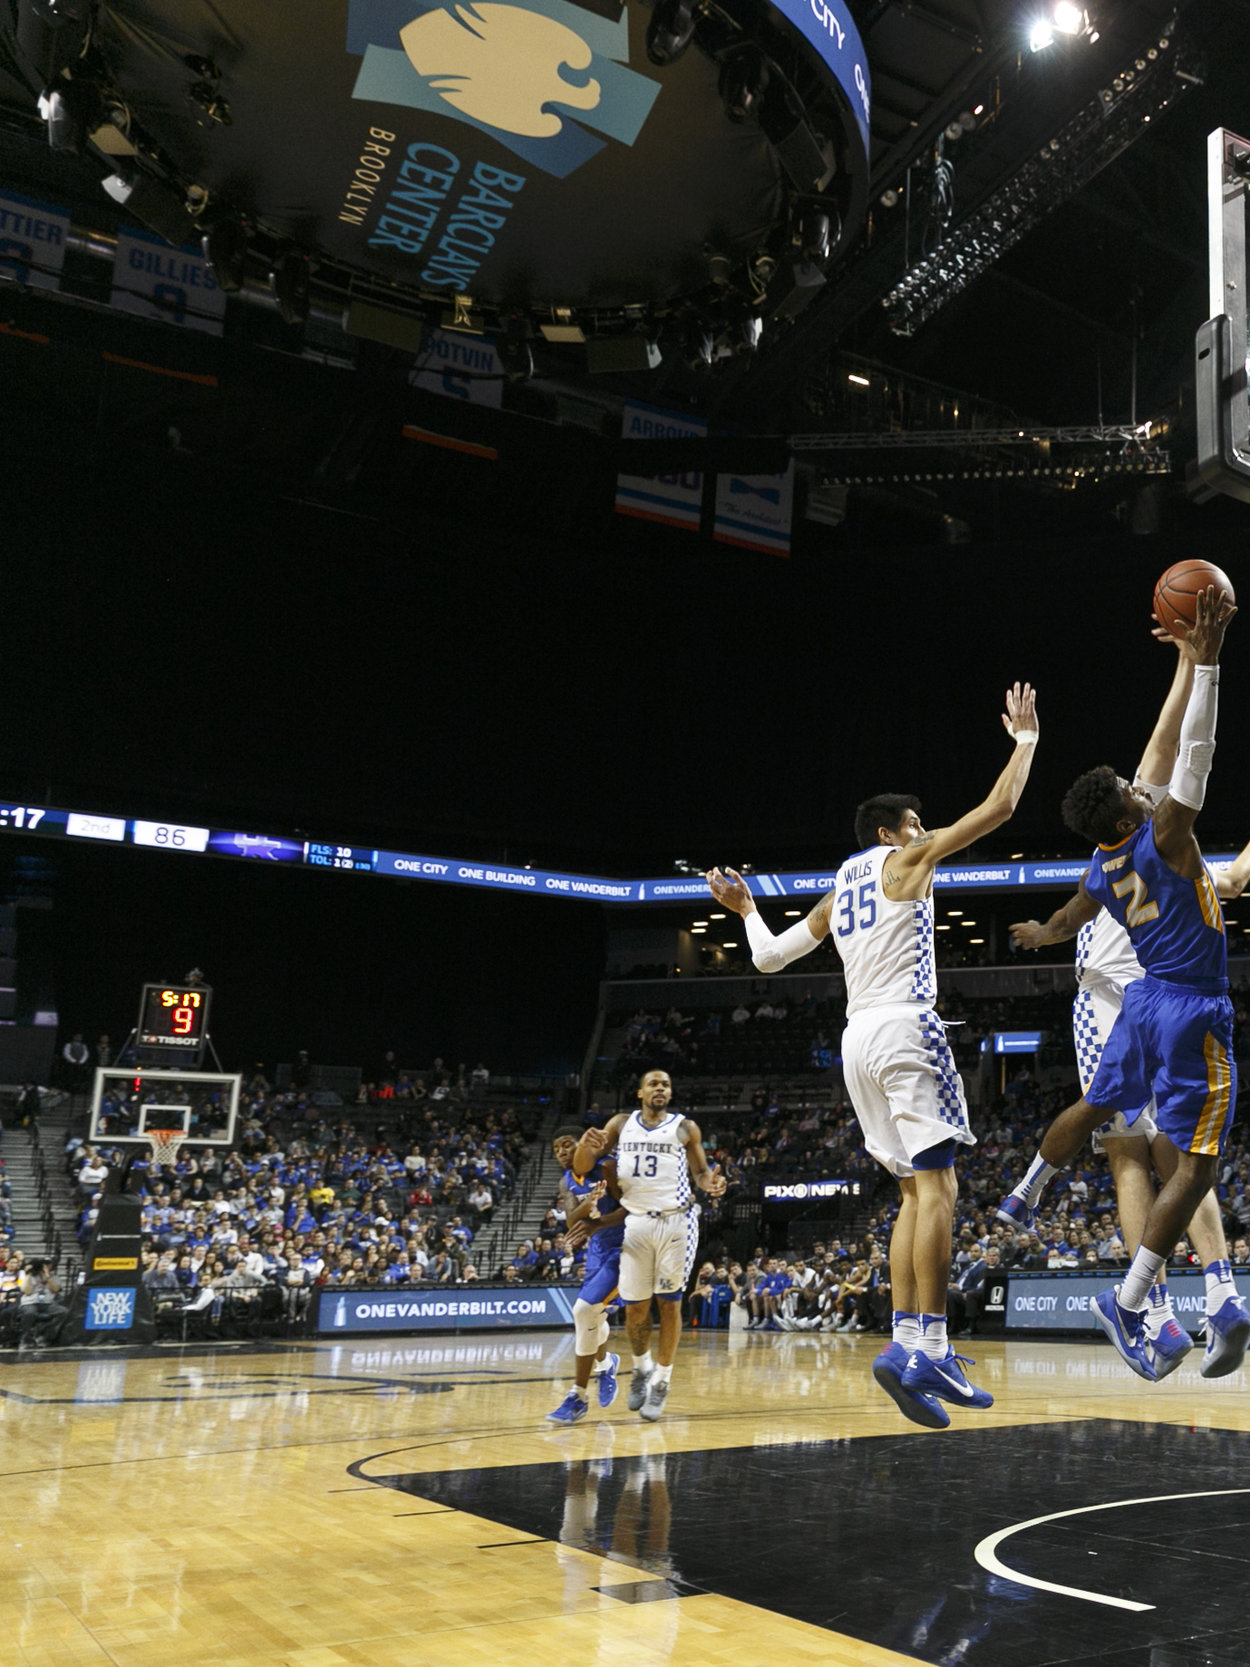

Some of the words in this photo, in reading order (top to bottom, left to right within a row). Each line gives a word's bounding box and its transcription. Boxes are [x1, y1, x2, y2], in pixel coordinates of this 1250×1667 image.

[338, 126, 396, 225] BROOKLYN
[367, 142, 460, 254] CENTER
[421, 160, 527, 291] BARCLAYS
[128, 248, 218, 290] GILLIES
[80, 819, 111, 835] 2nd
[154, 826, 187, 846] 86
[309, 853, 333, 866] TOL:
[310, 843, 333, 856] FLS:
[394, 859, 421, 873] ONE
[422, 862, 448, 875] CITY
[458, 867, 484, 880] ONE
[485, 870, 536, 887] BUILDING
[545, 878, 571, 890] ONE
[571, 881, 632, 896] VANDERBILT
[794, 879, 816, 889] ONE
[844, 860, 872, 885] WILLIS
[952, 870, 1010, 882] VANDERBILT
[837, 880, 876, 937] 35
[1111, 870, 1160, 928] 2
[161, 990, 200, 1007] 5:17
[173, 1007, 193, 1034] 9
[632, 1155, 658, 1177] 13
[90, 1302, 132, 1314] YORK
[96, 1292, 130, 1304] NEW
[355, 1300, 546, 1319] ONEVANDERBILT.COM
[1015, 1297, 1037, 1311] ONE
[1037, 1297, 1057, 1311] CITY
[1066, 1297, 1090, 1311] ONE
[94, 1312, 126, 1324] LIFE
